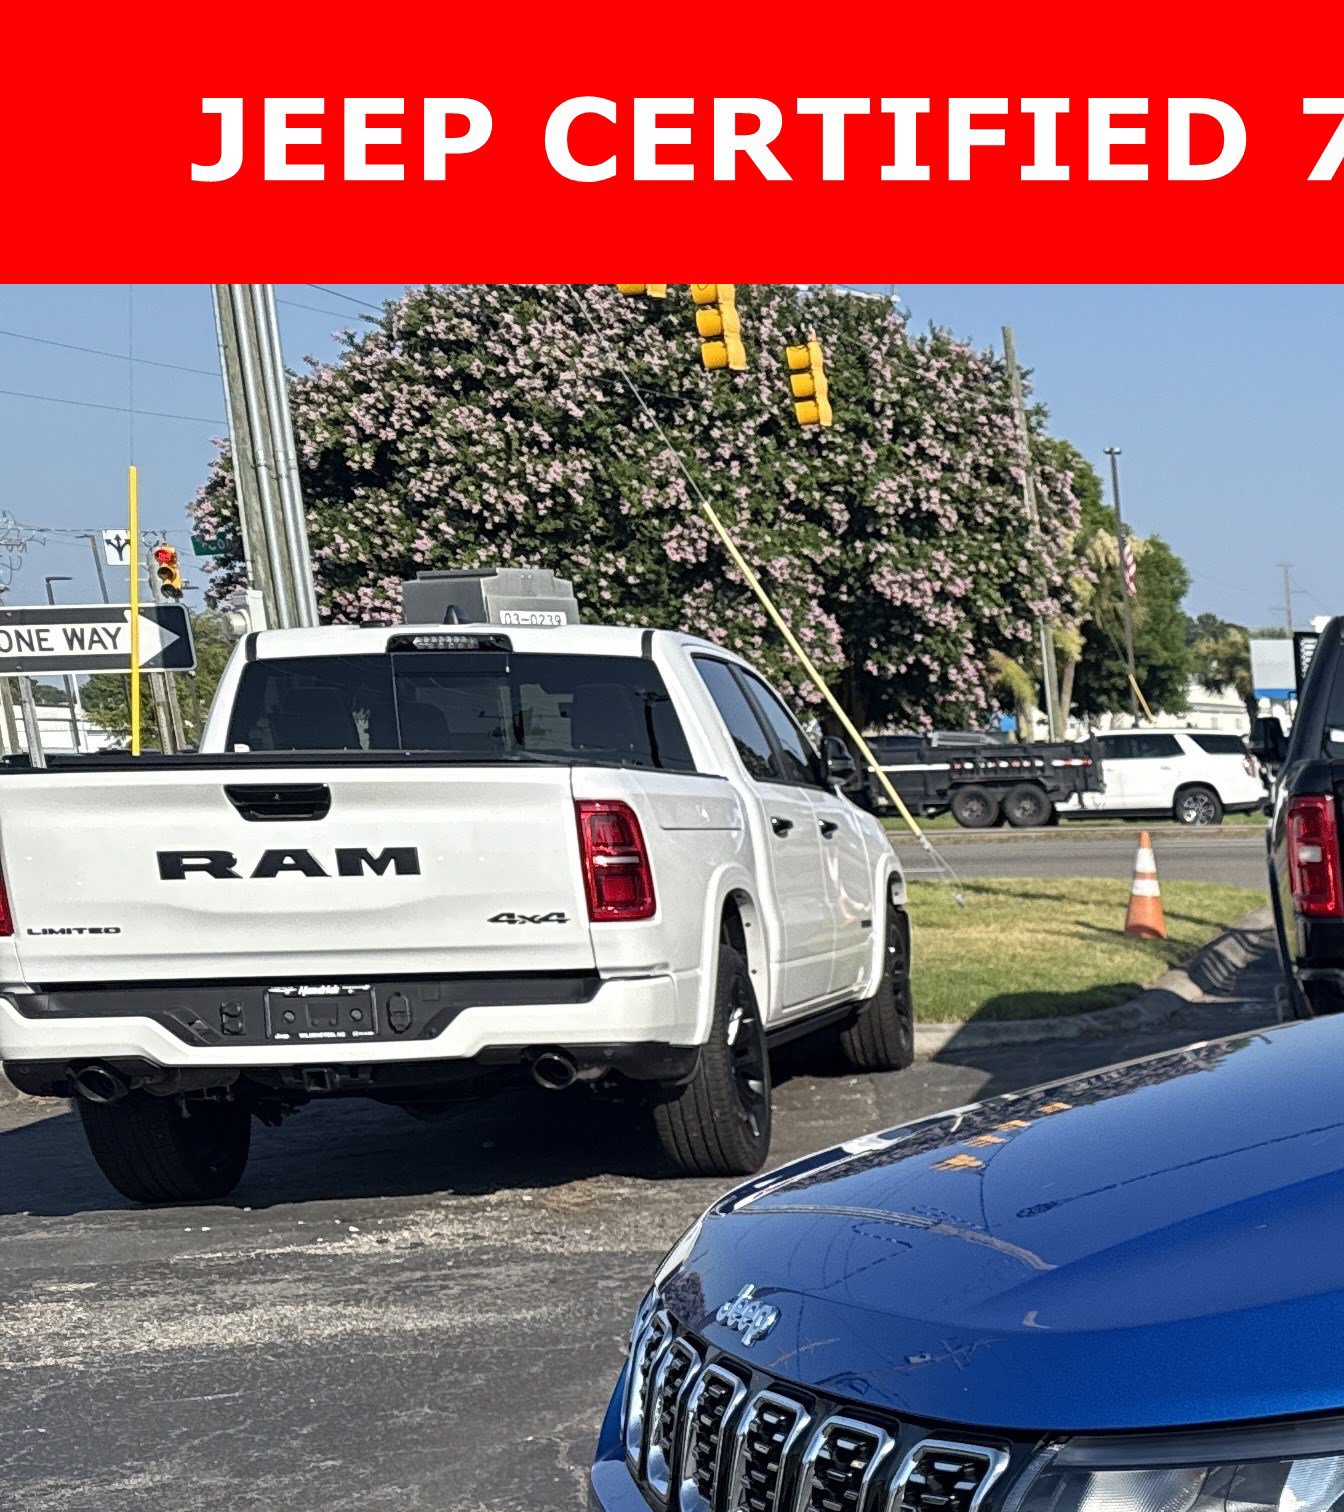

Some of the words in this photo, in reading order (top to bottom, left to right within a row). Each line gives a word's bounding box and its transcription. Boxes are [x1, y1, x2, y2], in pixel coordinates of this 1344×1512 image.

[0, 628, 54, 653] ONE
[62, 626, 122, 650] WAY
[156, 846, 421, 881] RAM
[26, 926, 122, 936] LIMITED
[486, 911, 571, 925] 4x4
[715, 1283, 779, 1347] Jeep
